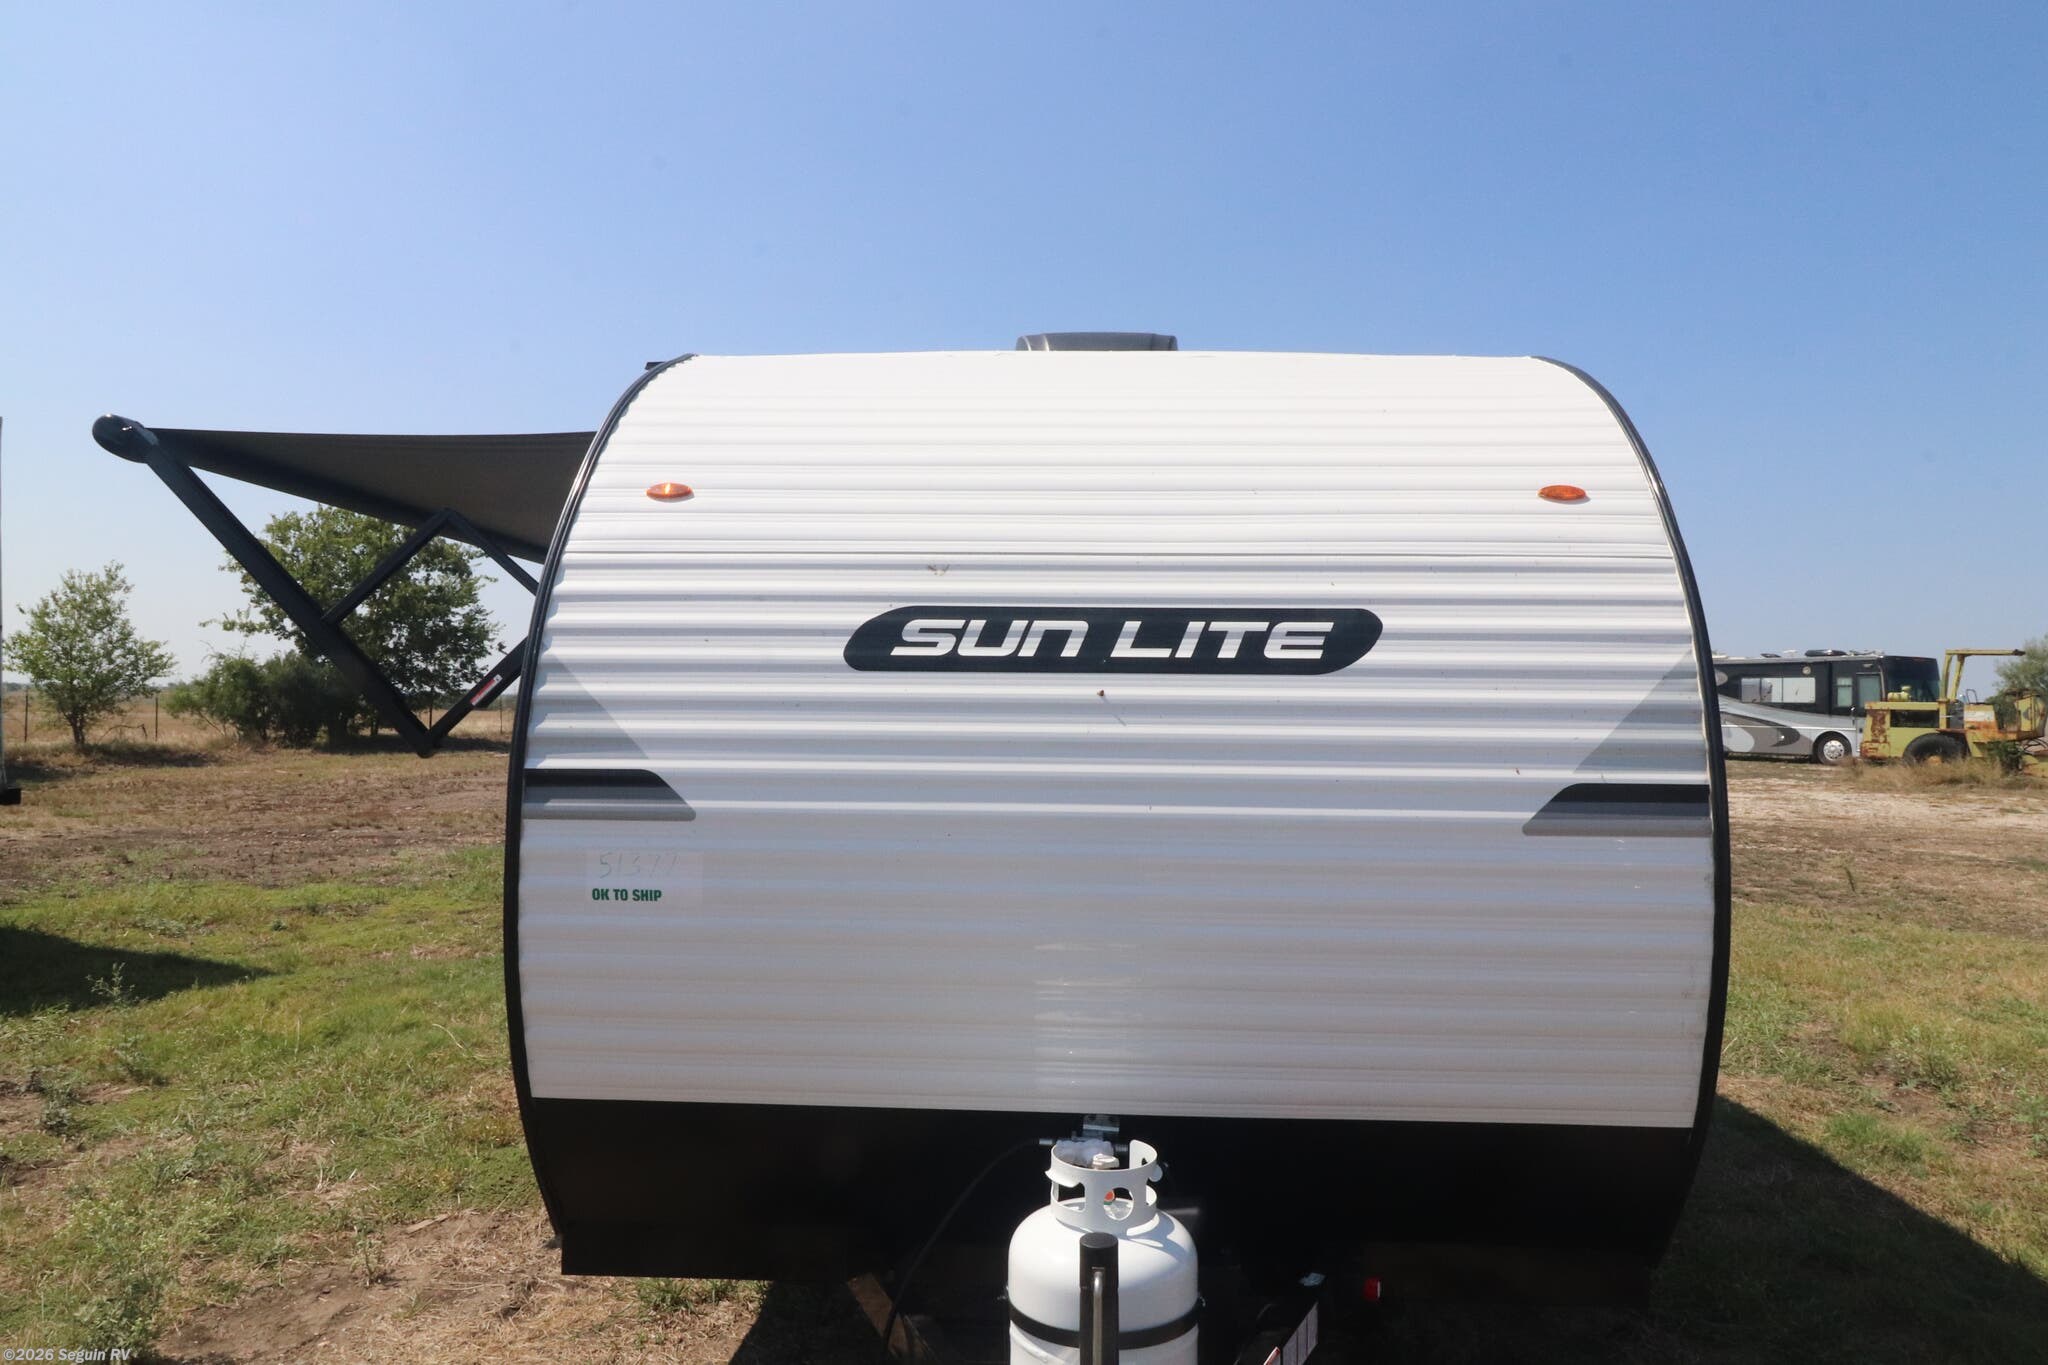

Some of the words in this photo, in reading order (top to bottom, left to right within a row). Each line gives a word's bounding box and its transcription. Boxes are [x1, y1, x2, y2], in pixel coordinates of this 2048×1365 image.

[890, 618, 1089, 658] SUN
[1110, 620, 1335, 660] LITE
[592, 888, 610, 901] OK
[613, 888, 629, 901] TO
[632, 889, 662, 902] SHIP
